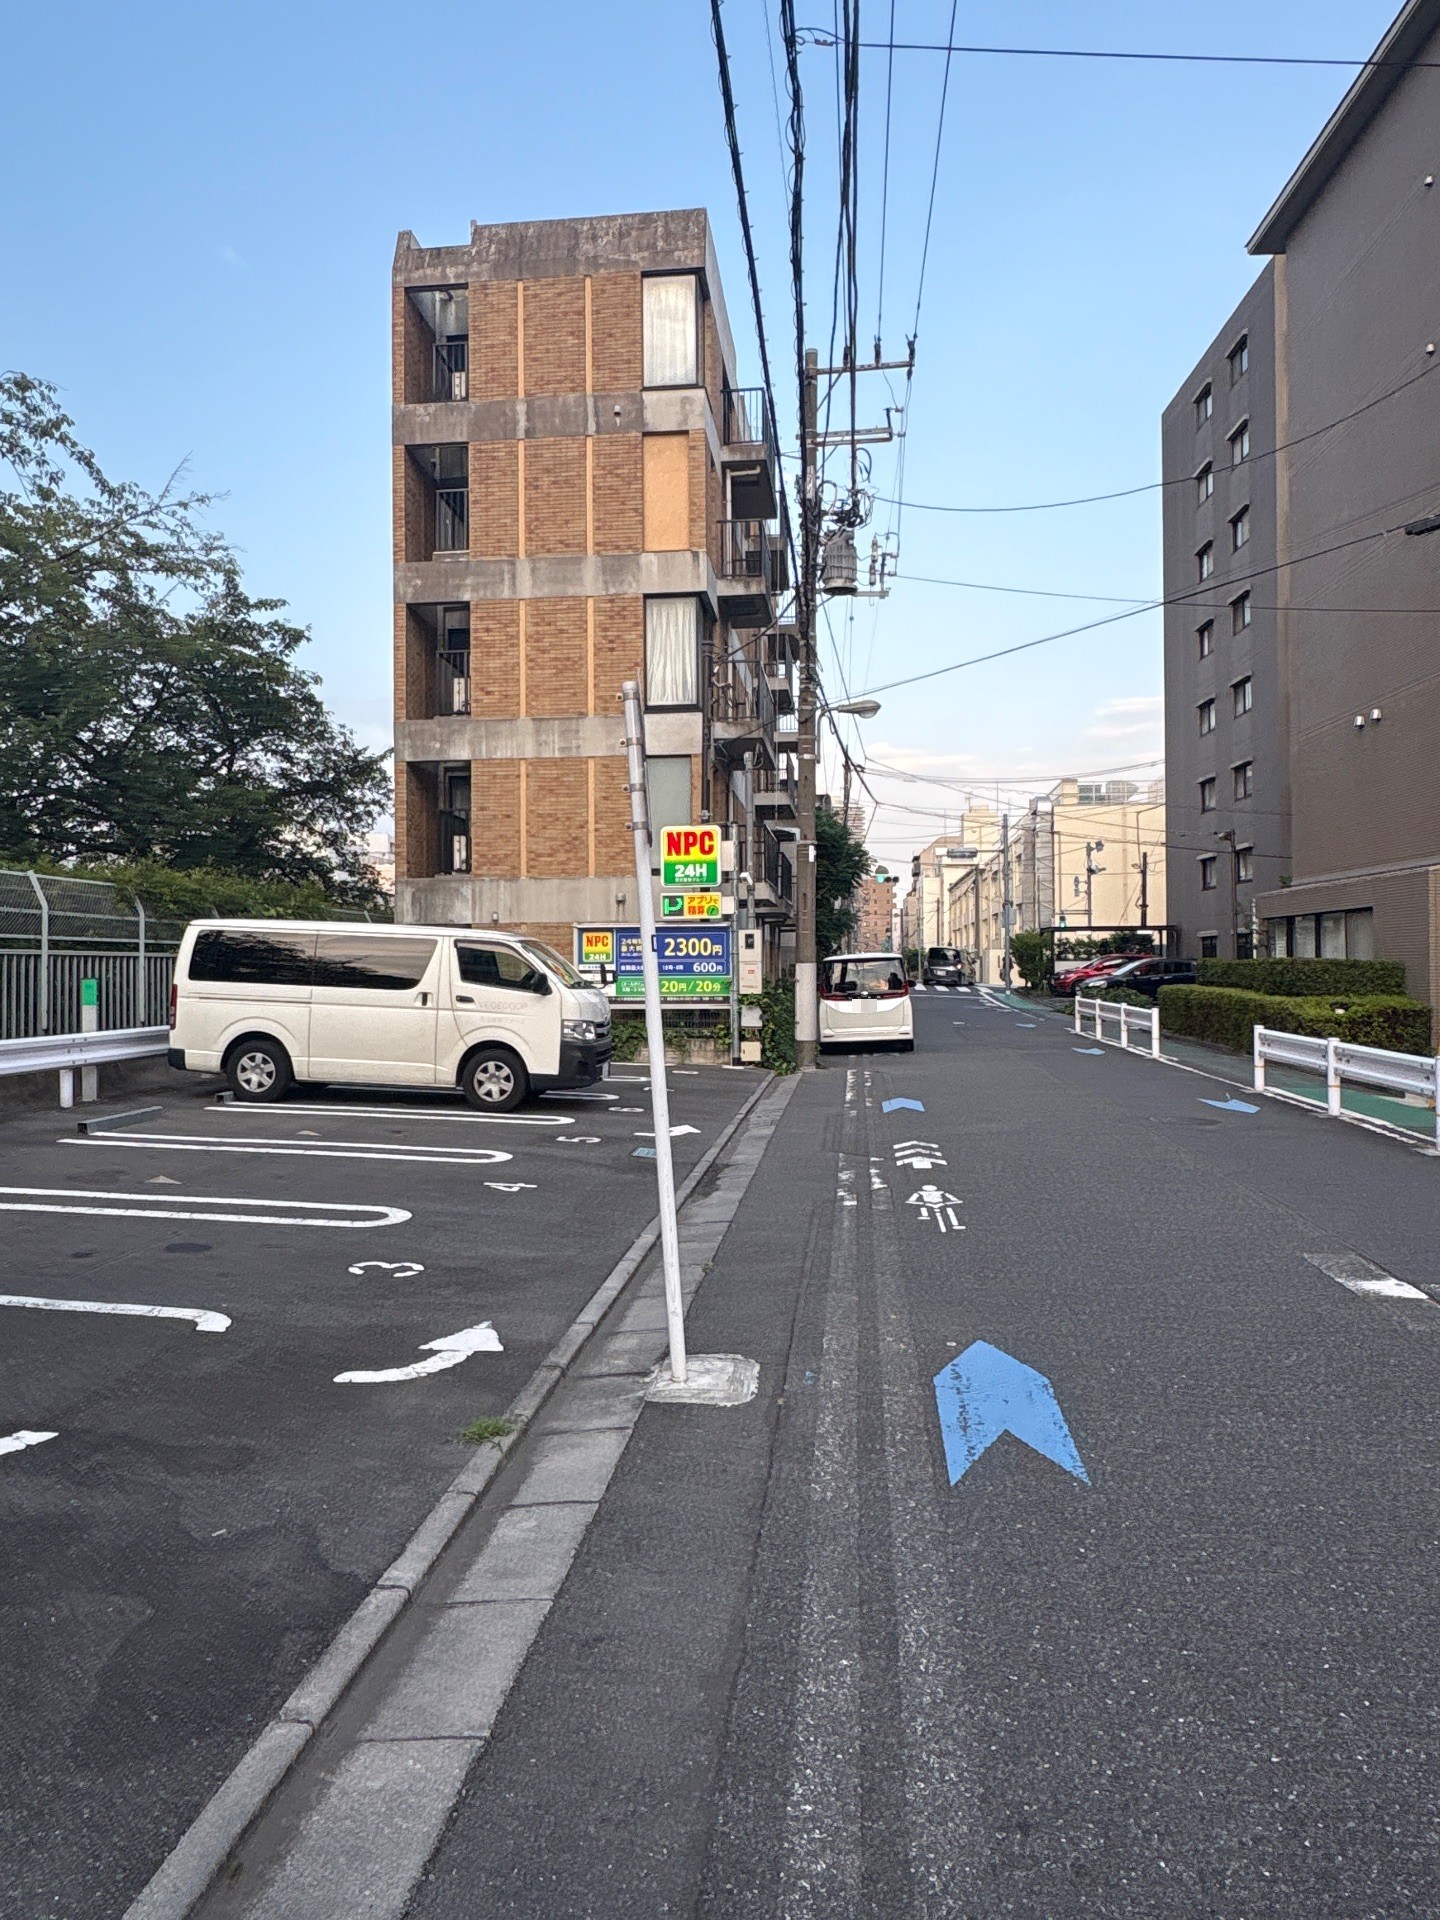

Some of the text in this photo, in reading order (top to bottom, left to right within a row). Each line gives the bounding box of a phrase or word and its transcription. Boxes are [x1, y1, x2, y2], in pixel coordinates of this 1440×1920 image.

[666, 831, 715, 856] NPC
[674, 863, 708, 877] 24H
[687, 896, 719, 905] アプリで
[585, 935, 609, 947] NPC
[664, 937, 723, 957] 2300円
[588, 953, 607, 961] 24H
[693, 962, 723, 973] 600円
[555, 1135, 602, 1144] 5
[483, 1182, 538, 1192] 4
[348, 1260, 425, 1278] 3
